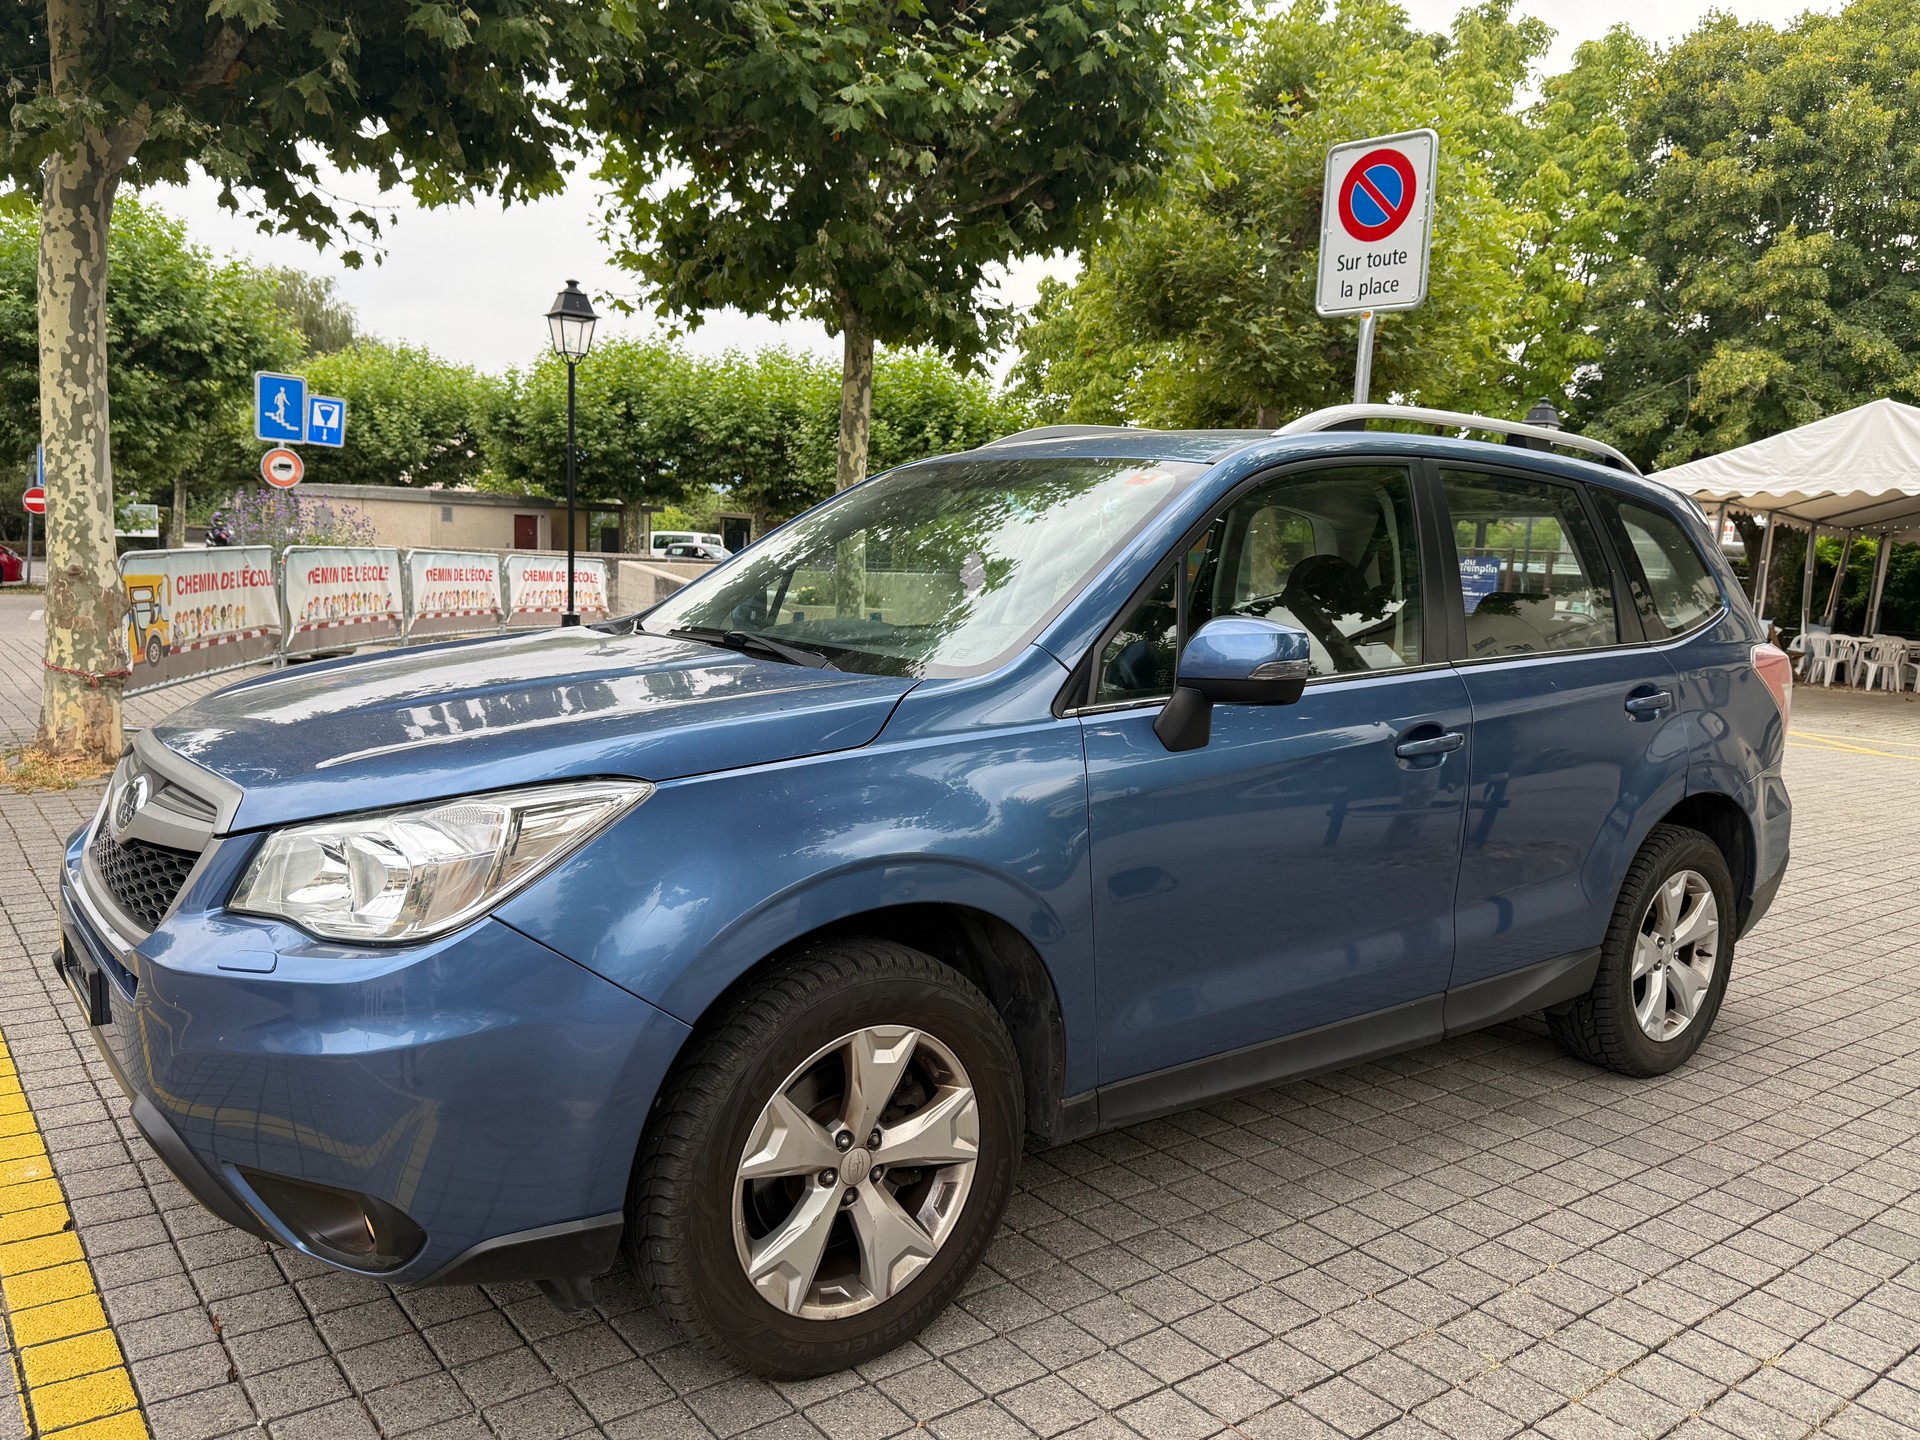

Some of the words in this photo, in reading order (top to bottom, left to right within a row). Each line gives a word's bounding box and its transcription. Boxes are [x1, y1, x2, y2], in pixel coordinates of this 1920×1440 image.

[1336, 254, 1361, 272] Sur
[1367, 249, 1408, 268] toute
[1340, 280, 1353, 298] la
[1358, 276, 1399, 301] place
[176, 572, 219, 596] CHEMIN
[220, 571, 235, 591] DE
[341, 566, 353, 583] DE
[453, 568, 464, 582] DE
[522, 569, 554, 583] CHEMIN
[555, 570, 566, 583] DE
